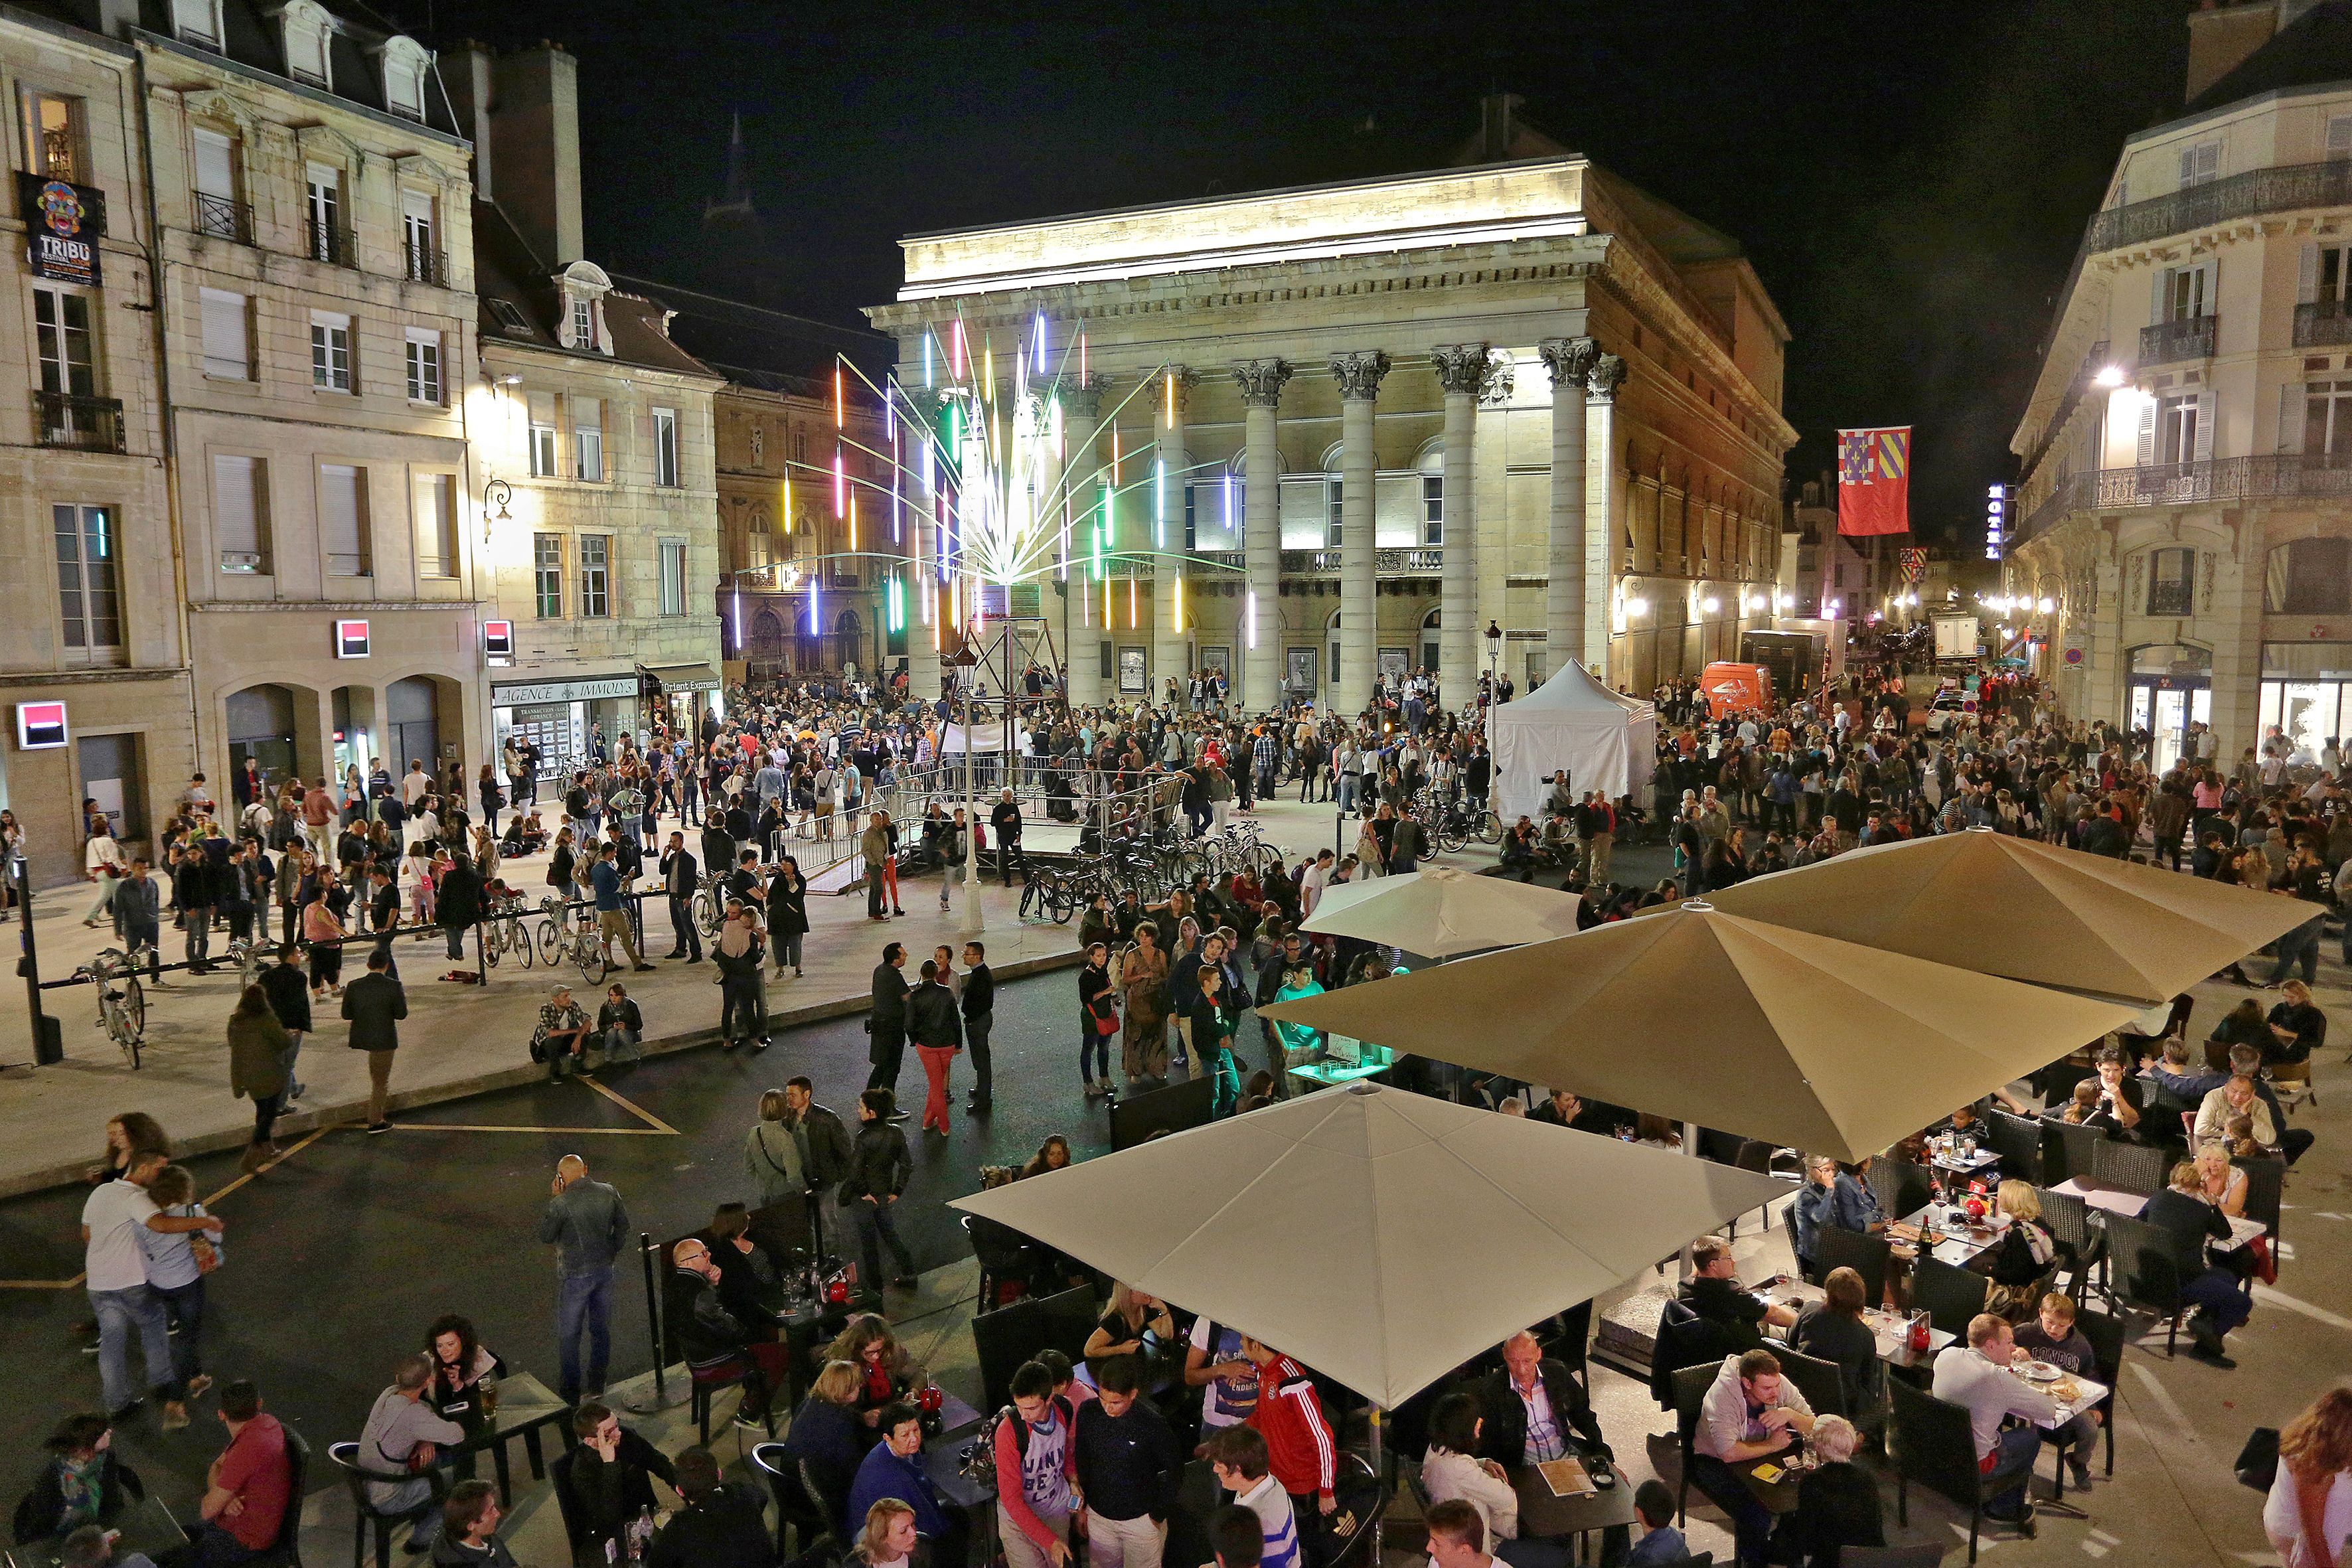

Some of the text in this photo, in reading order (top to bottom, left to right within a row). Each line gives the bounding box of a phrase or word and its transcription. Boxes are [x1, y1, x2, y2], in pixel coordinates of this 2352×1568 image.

[40, 236, 90, 262] TRIBU
[1985, 485, 2003, 559] HOTEL
[501, 681, 633, 702] AGENCE IMMOLYS
[643, 679, 663, 688] Orie
[2031, 1346, 2080, 1373] LONDON
[1232, 1382, 1259, 1391] ENDLES
